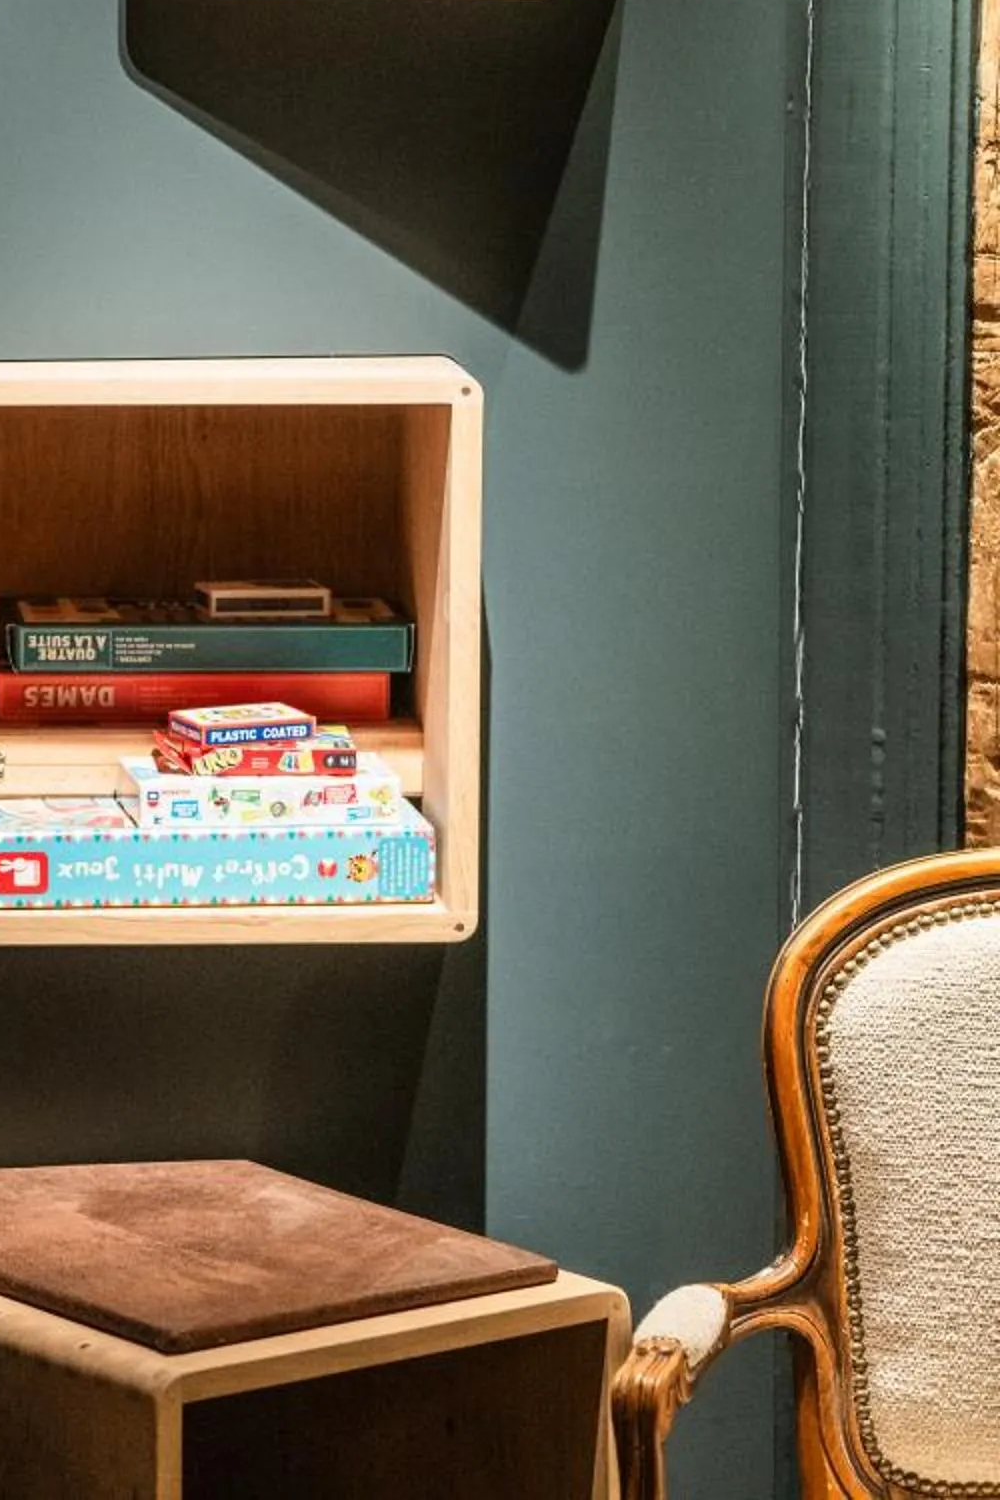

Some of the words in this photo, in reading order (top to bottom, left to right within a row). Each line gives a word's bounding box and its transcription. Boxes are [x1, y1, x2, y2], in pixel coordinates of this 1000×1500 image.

[28, 635, 71, 649] SUITE
[74, 636, 93, 649] LA
[38, 648, 96, 662] QUATRE
[24, 685, 115, 708] DAMES
[210, 728, 257, 743] PLASTIC
[263, 725, 307, 738] COATED
[57, 855, 120, 882] Jeux
[133, 861, 204, 890] Multi
[212, 853, 310, 886] Coffret
